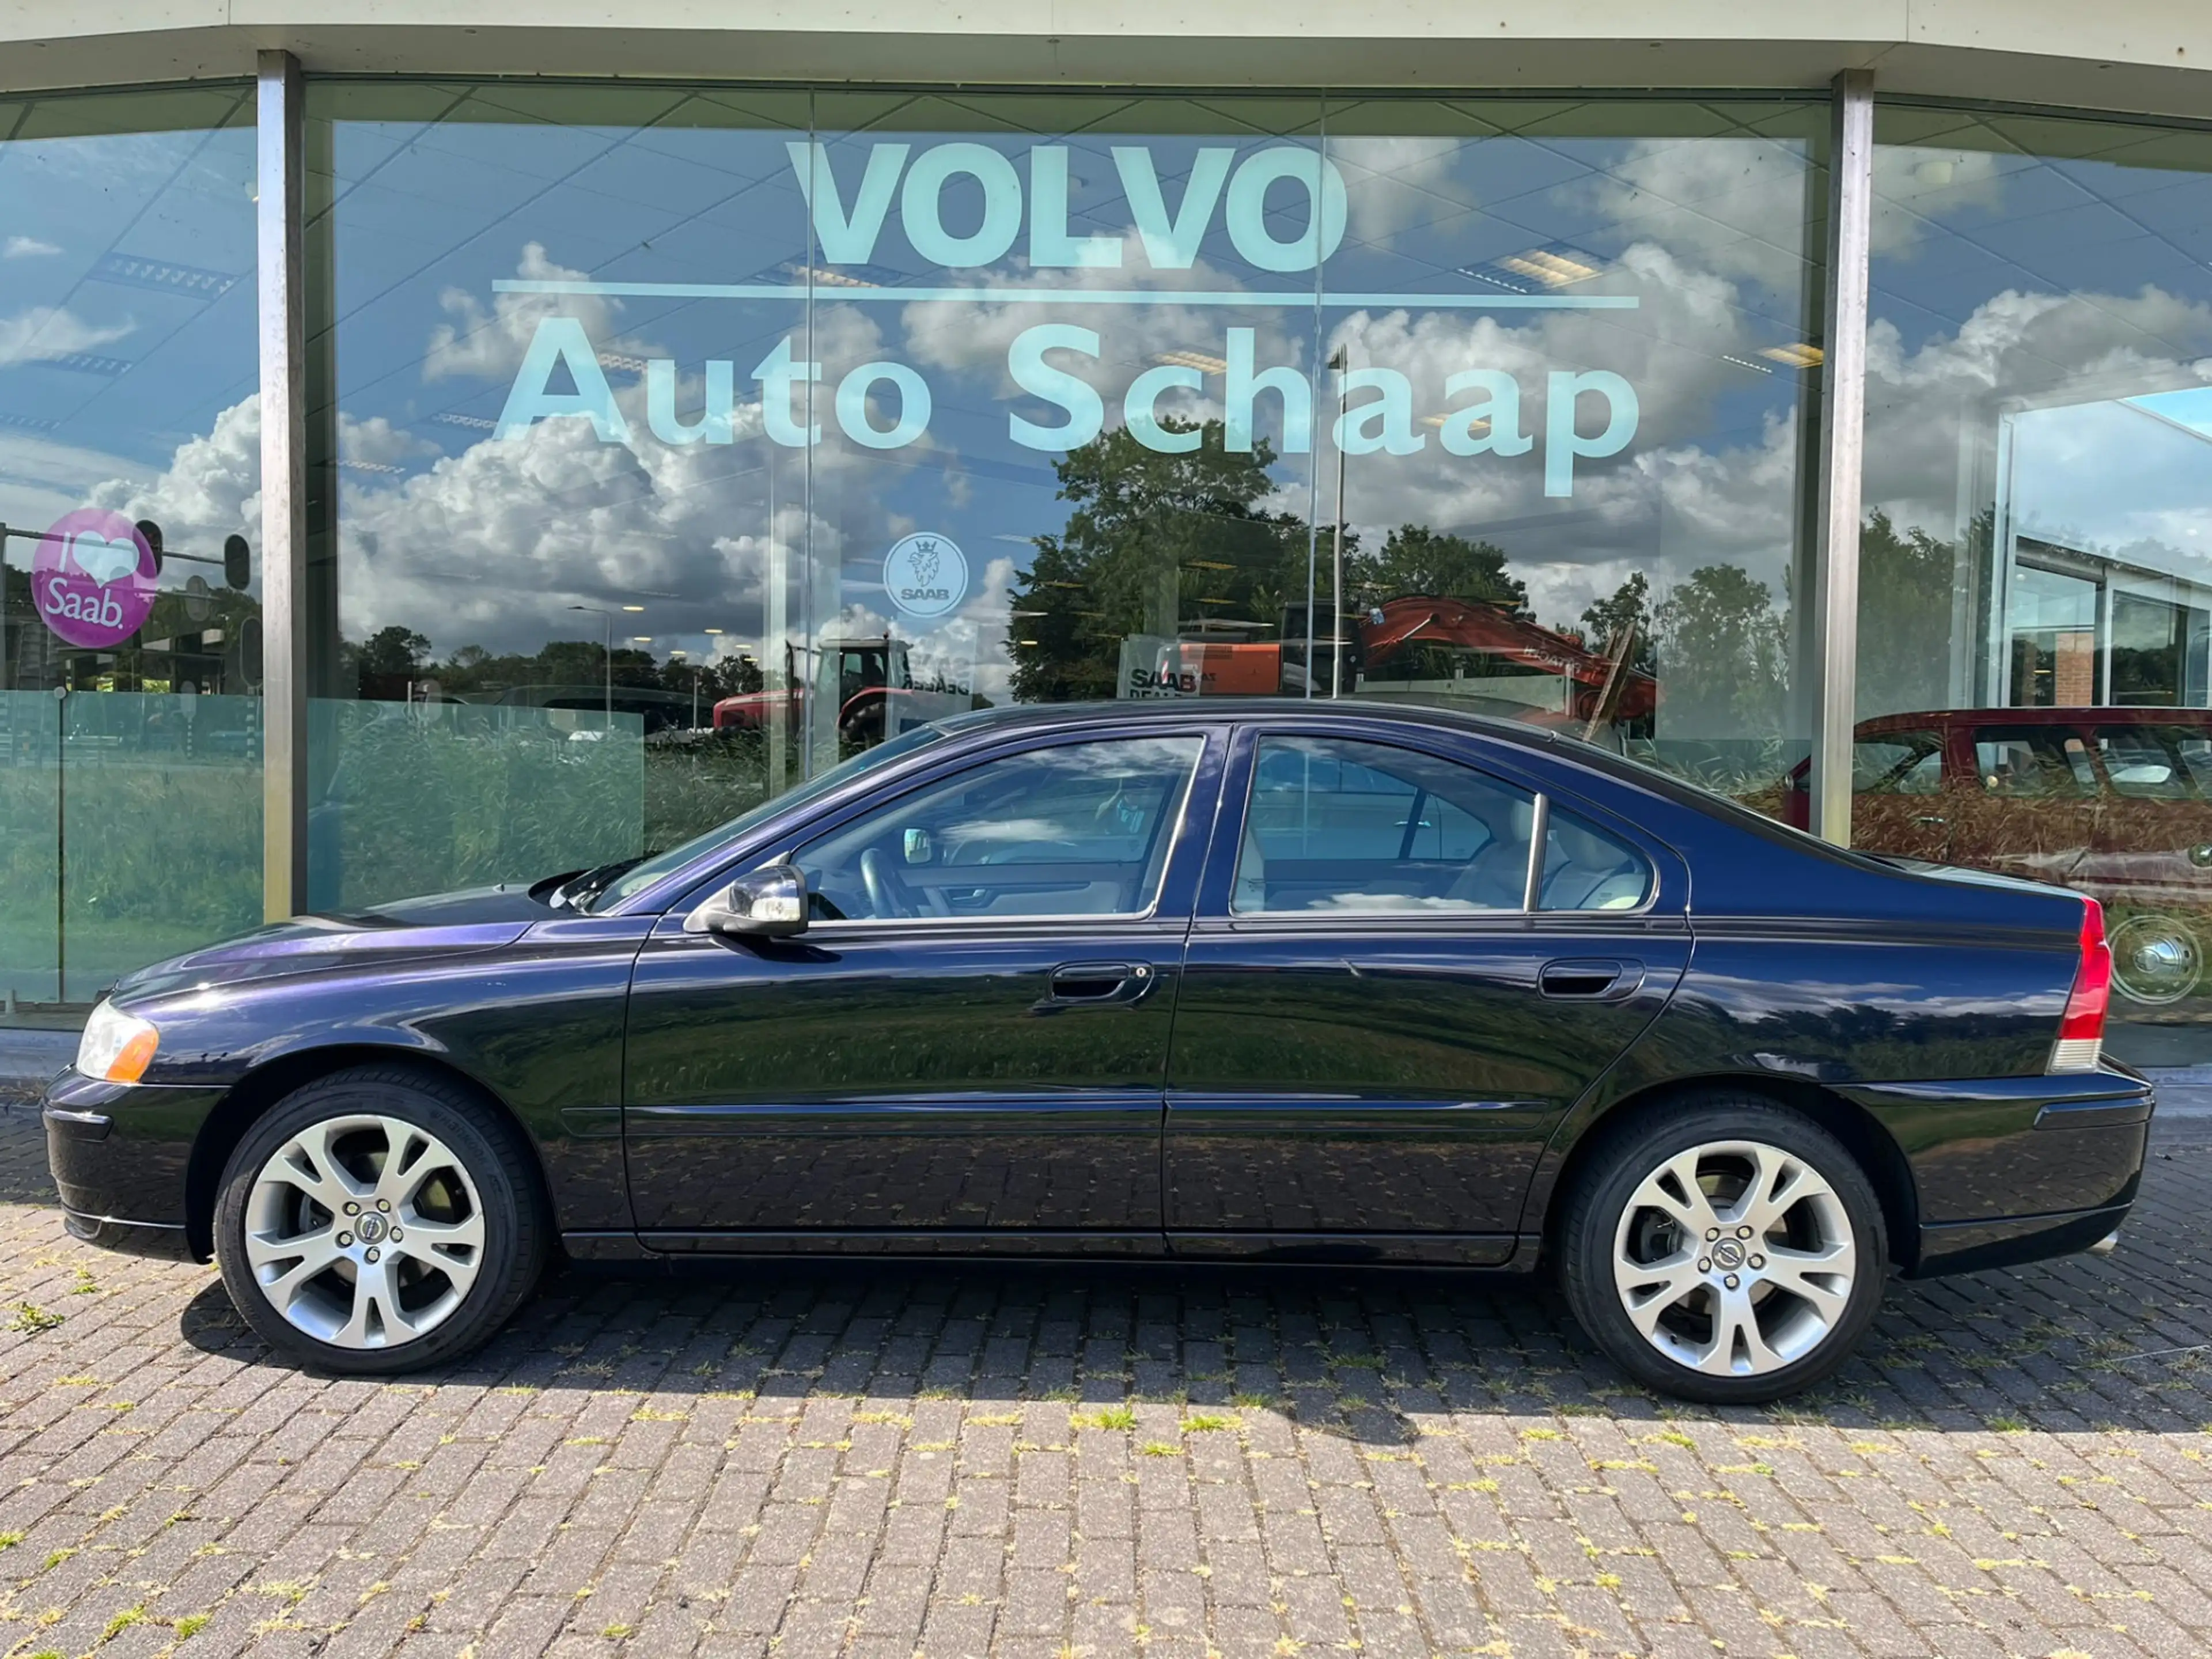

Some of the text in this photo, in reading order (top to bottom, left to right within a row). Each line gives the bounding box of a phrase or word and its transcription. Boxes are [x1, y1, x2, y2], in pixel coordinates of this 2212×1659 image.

[785, 142, 1347, 271] VOLVO
[492, 317, 1639, 497] Auto Schaap
[59, 531, 71, 572] I
[901, 589, 949, 600] SAAB
[1131, 669, 1196, 692] SAAB
